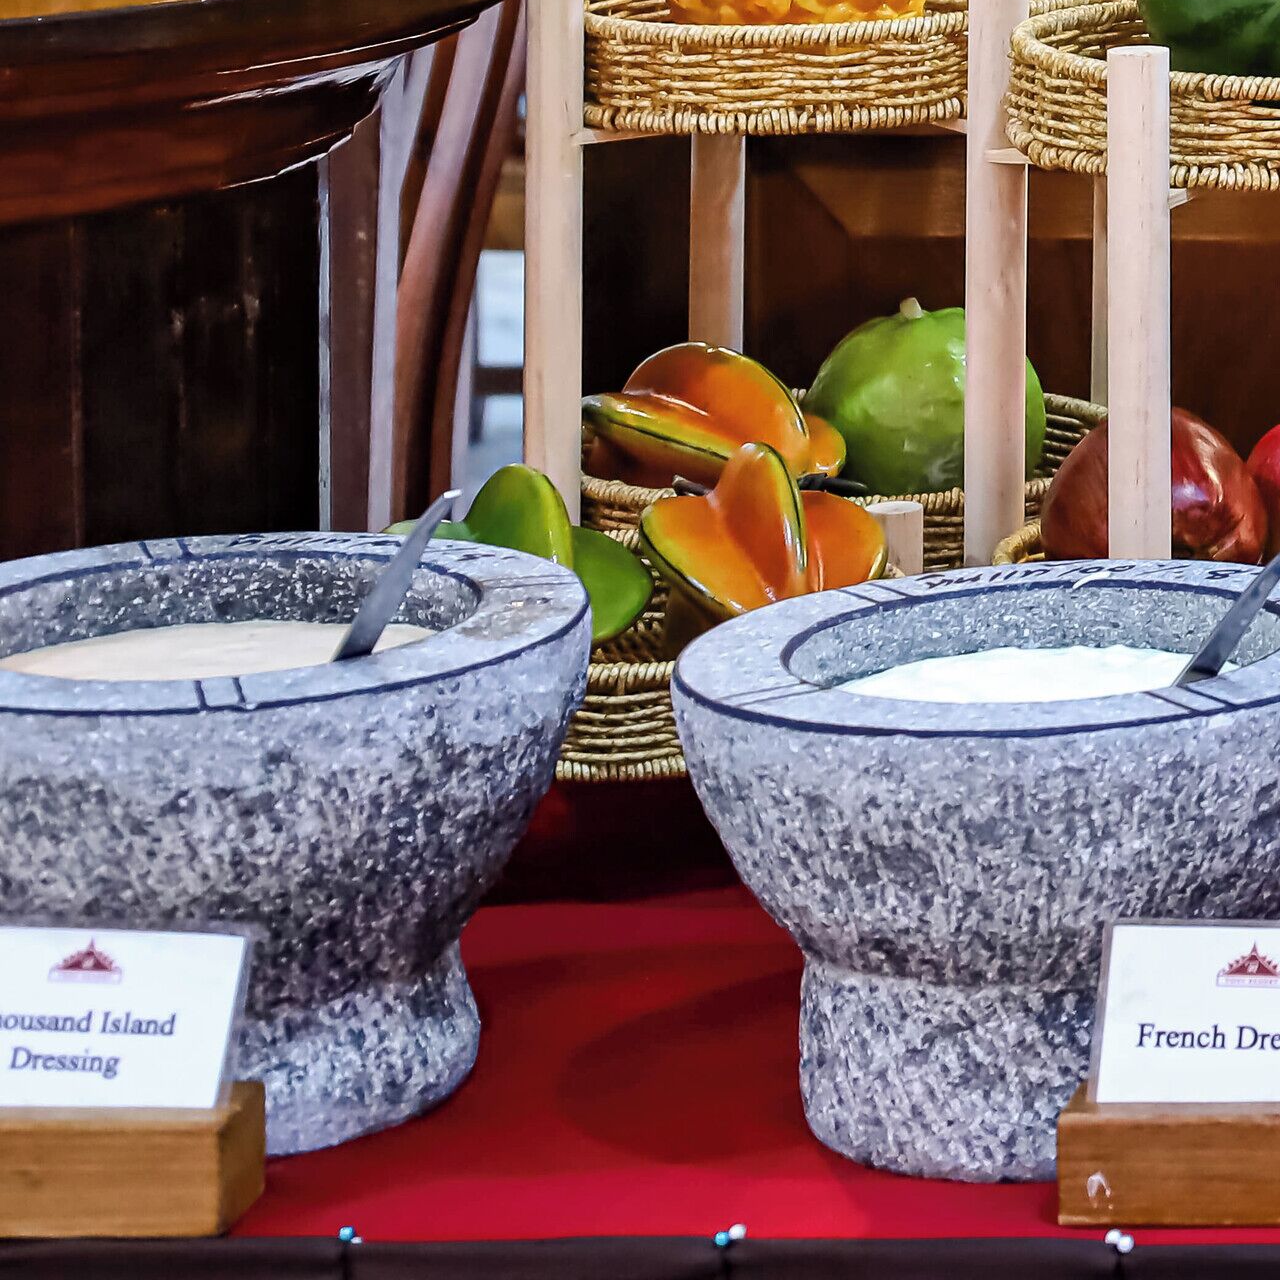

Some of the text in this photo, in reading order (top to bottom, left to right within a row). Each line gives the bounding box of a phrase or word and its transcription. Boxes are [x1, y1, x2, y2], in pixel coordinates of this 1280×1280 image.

[100, 1011, 177, 1036] Island
[1136, 1023, 1226, 1050] French
[10, 1046, 120, 1079] Dressing
